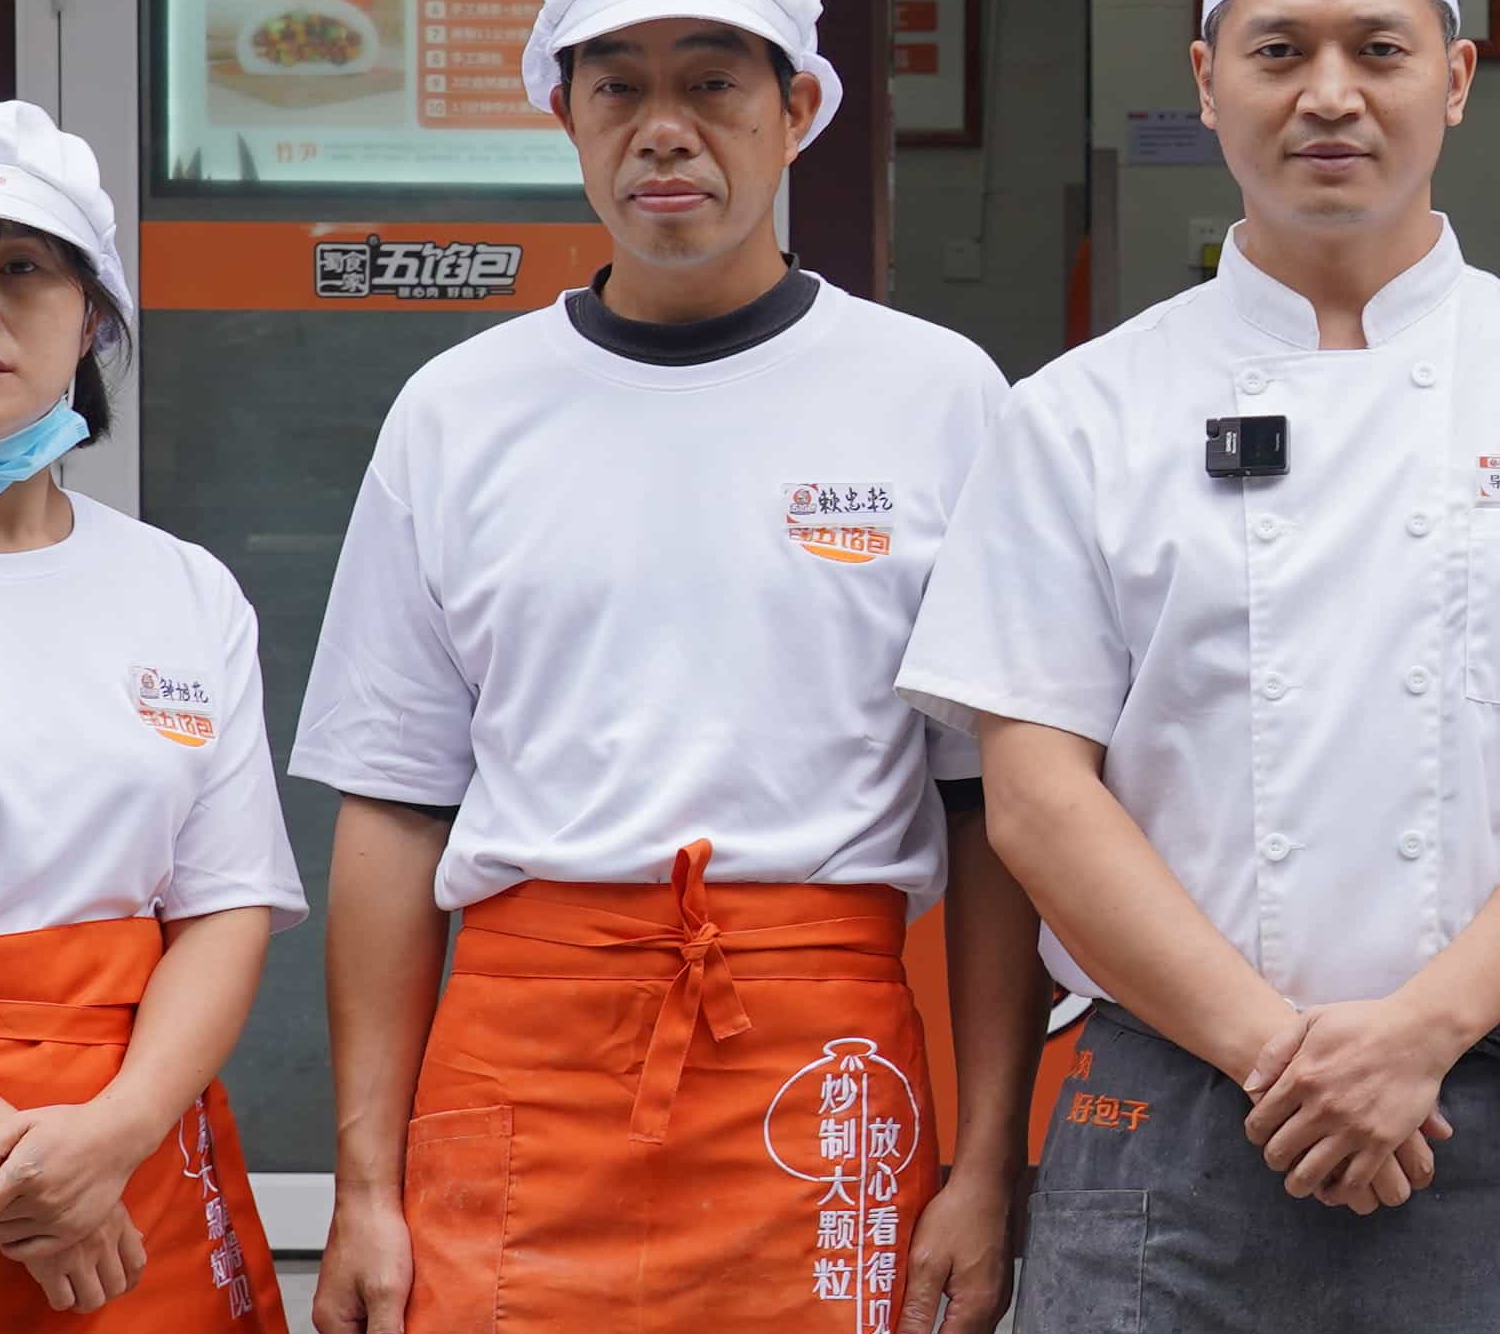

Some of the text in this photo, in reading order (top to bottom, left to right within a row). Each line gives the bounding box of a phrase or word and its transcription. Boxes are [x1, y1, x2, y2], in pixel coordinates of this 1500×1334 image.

[372, 243, 522, 286] 五馅包
[1067, 1091, 1150, 1132] 好包子
[812, 1073, 858, 1301] 炒制大颗粒
